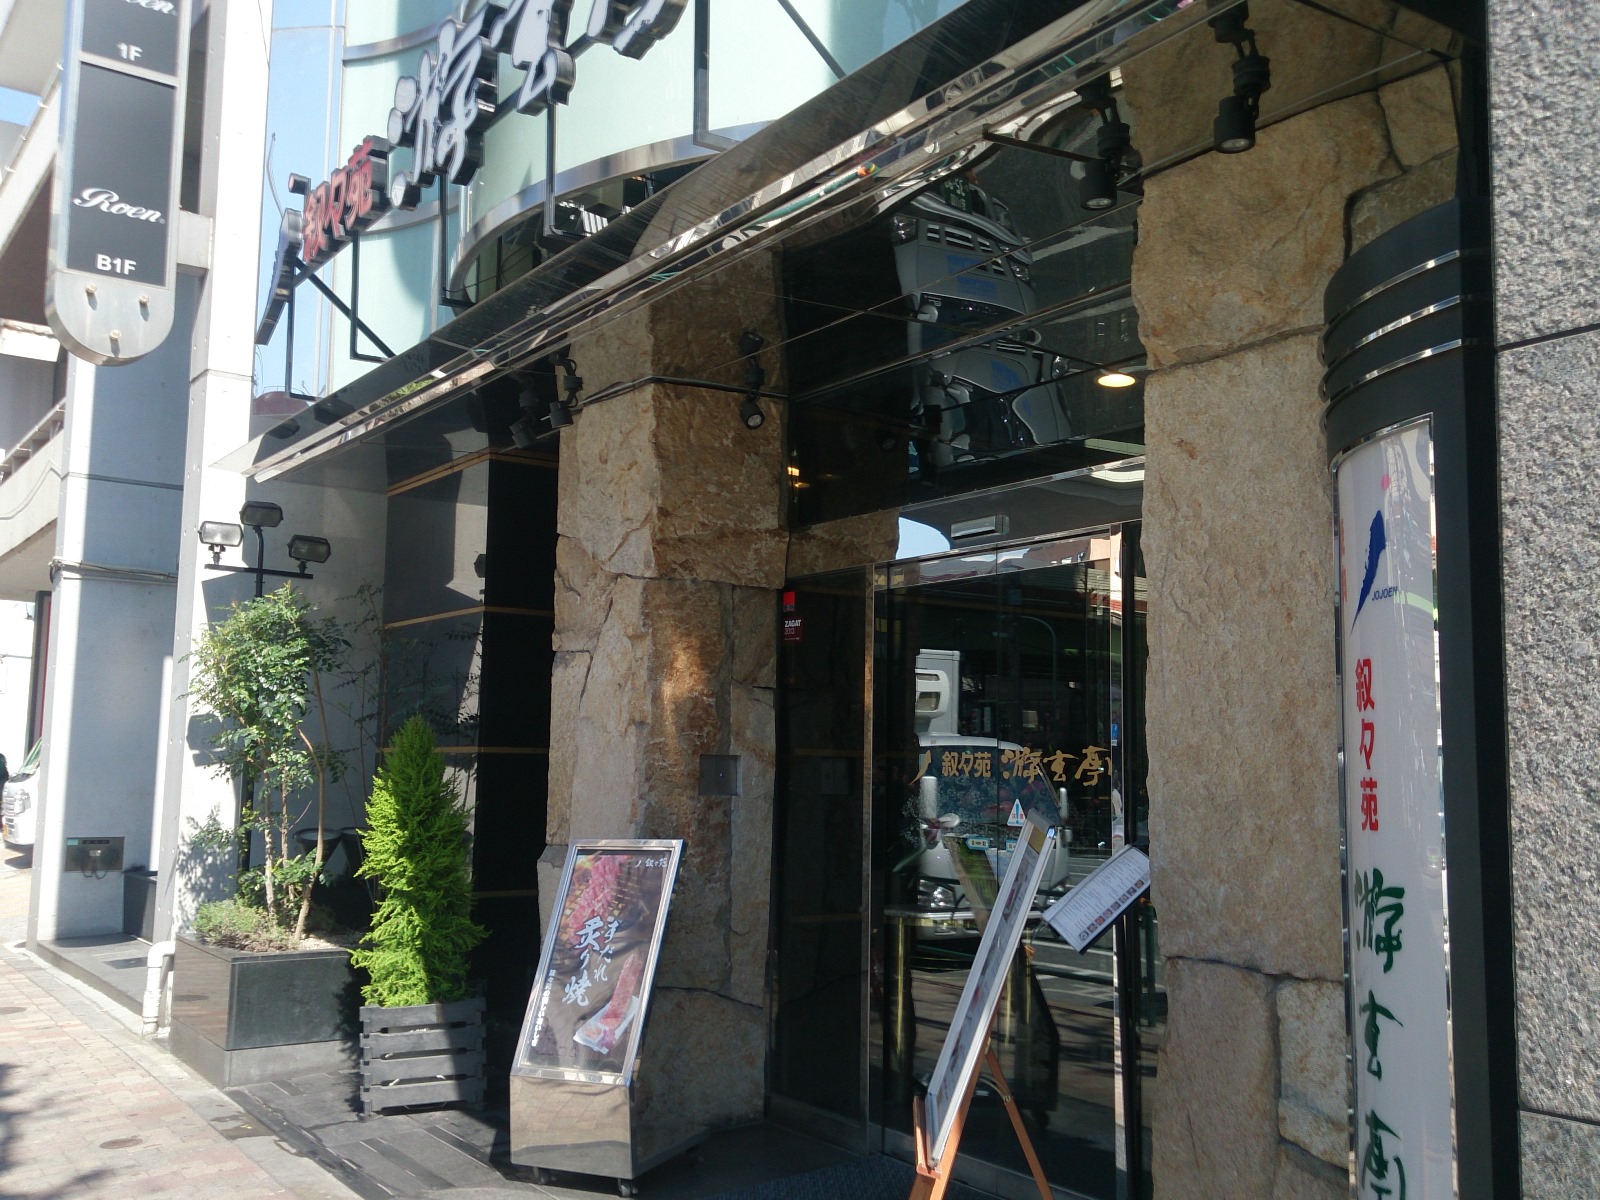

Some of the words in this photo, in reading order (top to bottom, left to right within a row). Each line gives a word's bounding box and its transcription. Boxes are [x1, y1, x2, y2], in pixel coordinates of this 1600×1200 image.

[118, 42, 143, 61] 1F
[73, 187, 162, 223] Roen
[96, 253, 137, 275] B1F
[1372, 586, 1399, 601] JOJOEN
[784, 619, 801, 628] ZAGAT
[1354, 658, 1379, 832] 叙々苑
[941, 751, 992, 778] 叙々苑
